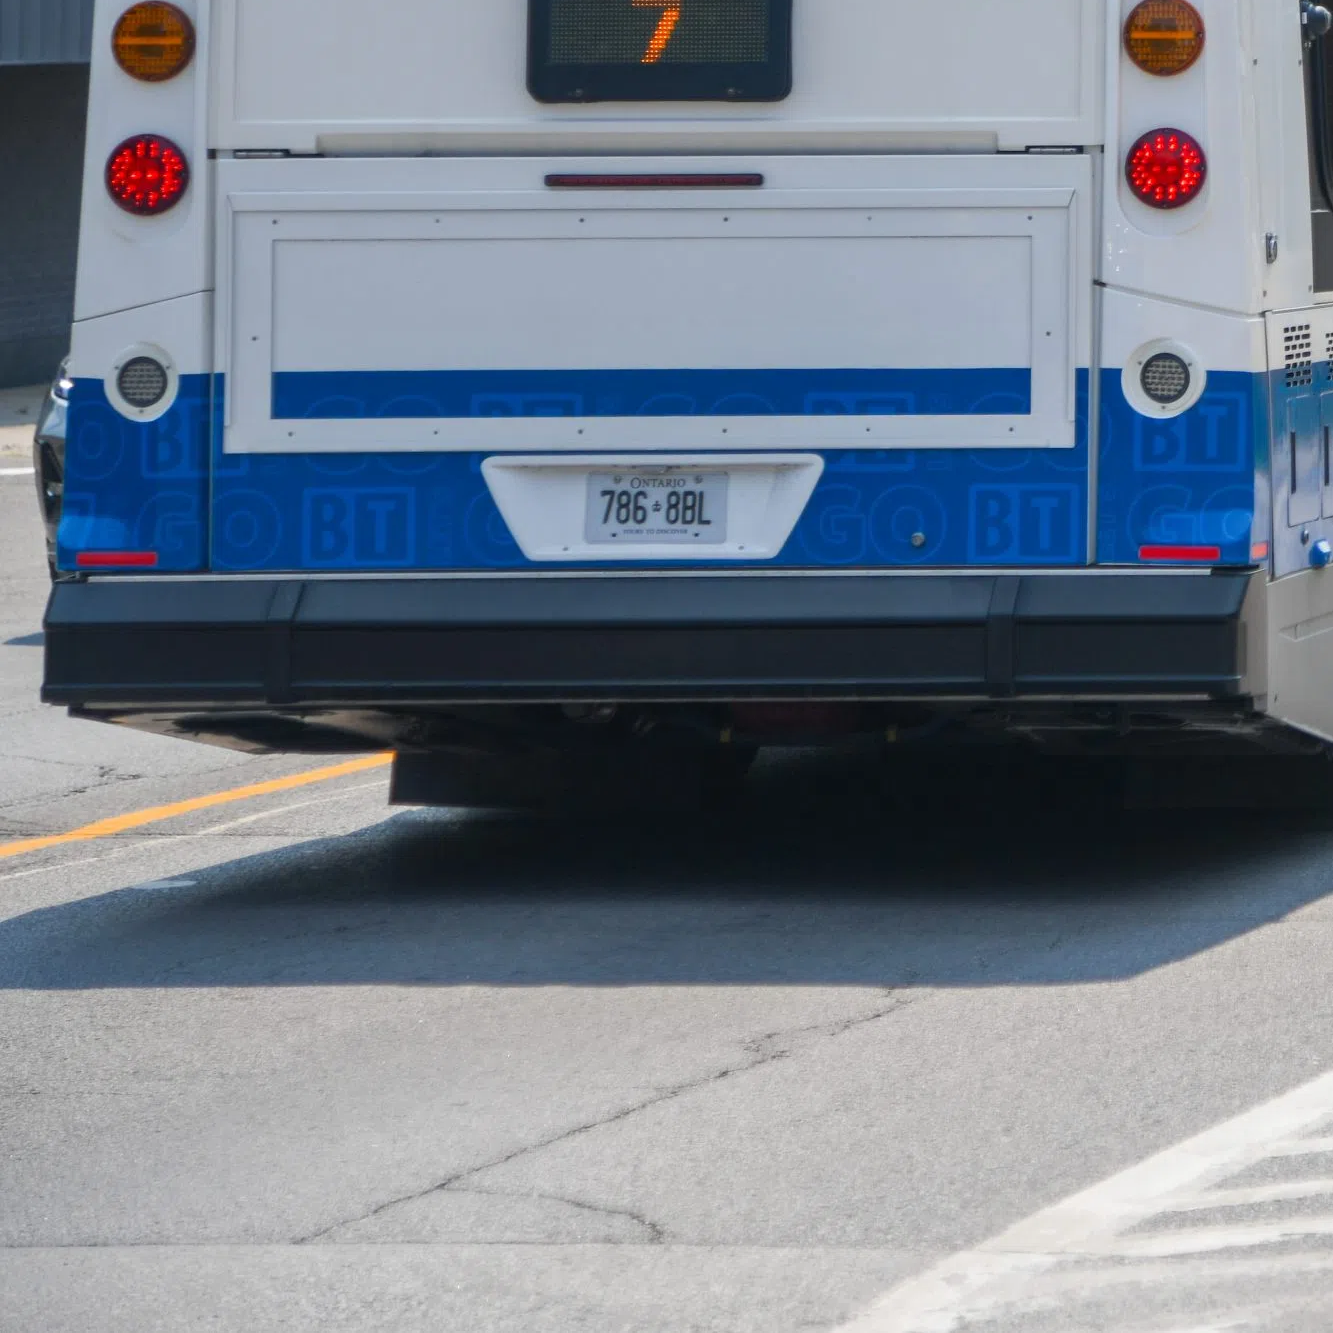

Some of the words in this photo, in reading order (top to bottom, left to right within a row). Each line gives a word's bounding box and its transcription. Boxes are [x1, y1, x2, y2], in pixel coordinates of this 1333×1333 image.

[630, 477, 686, 489] ONTARIO
[601, 490, 648, 525] 786
[665, 490, 712, 526] 8BL
